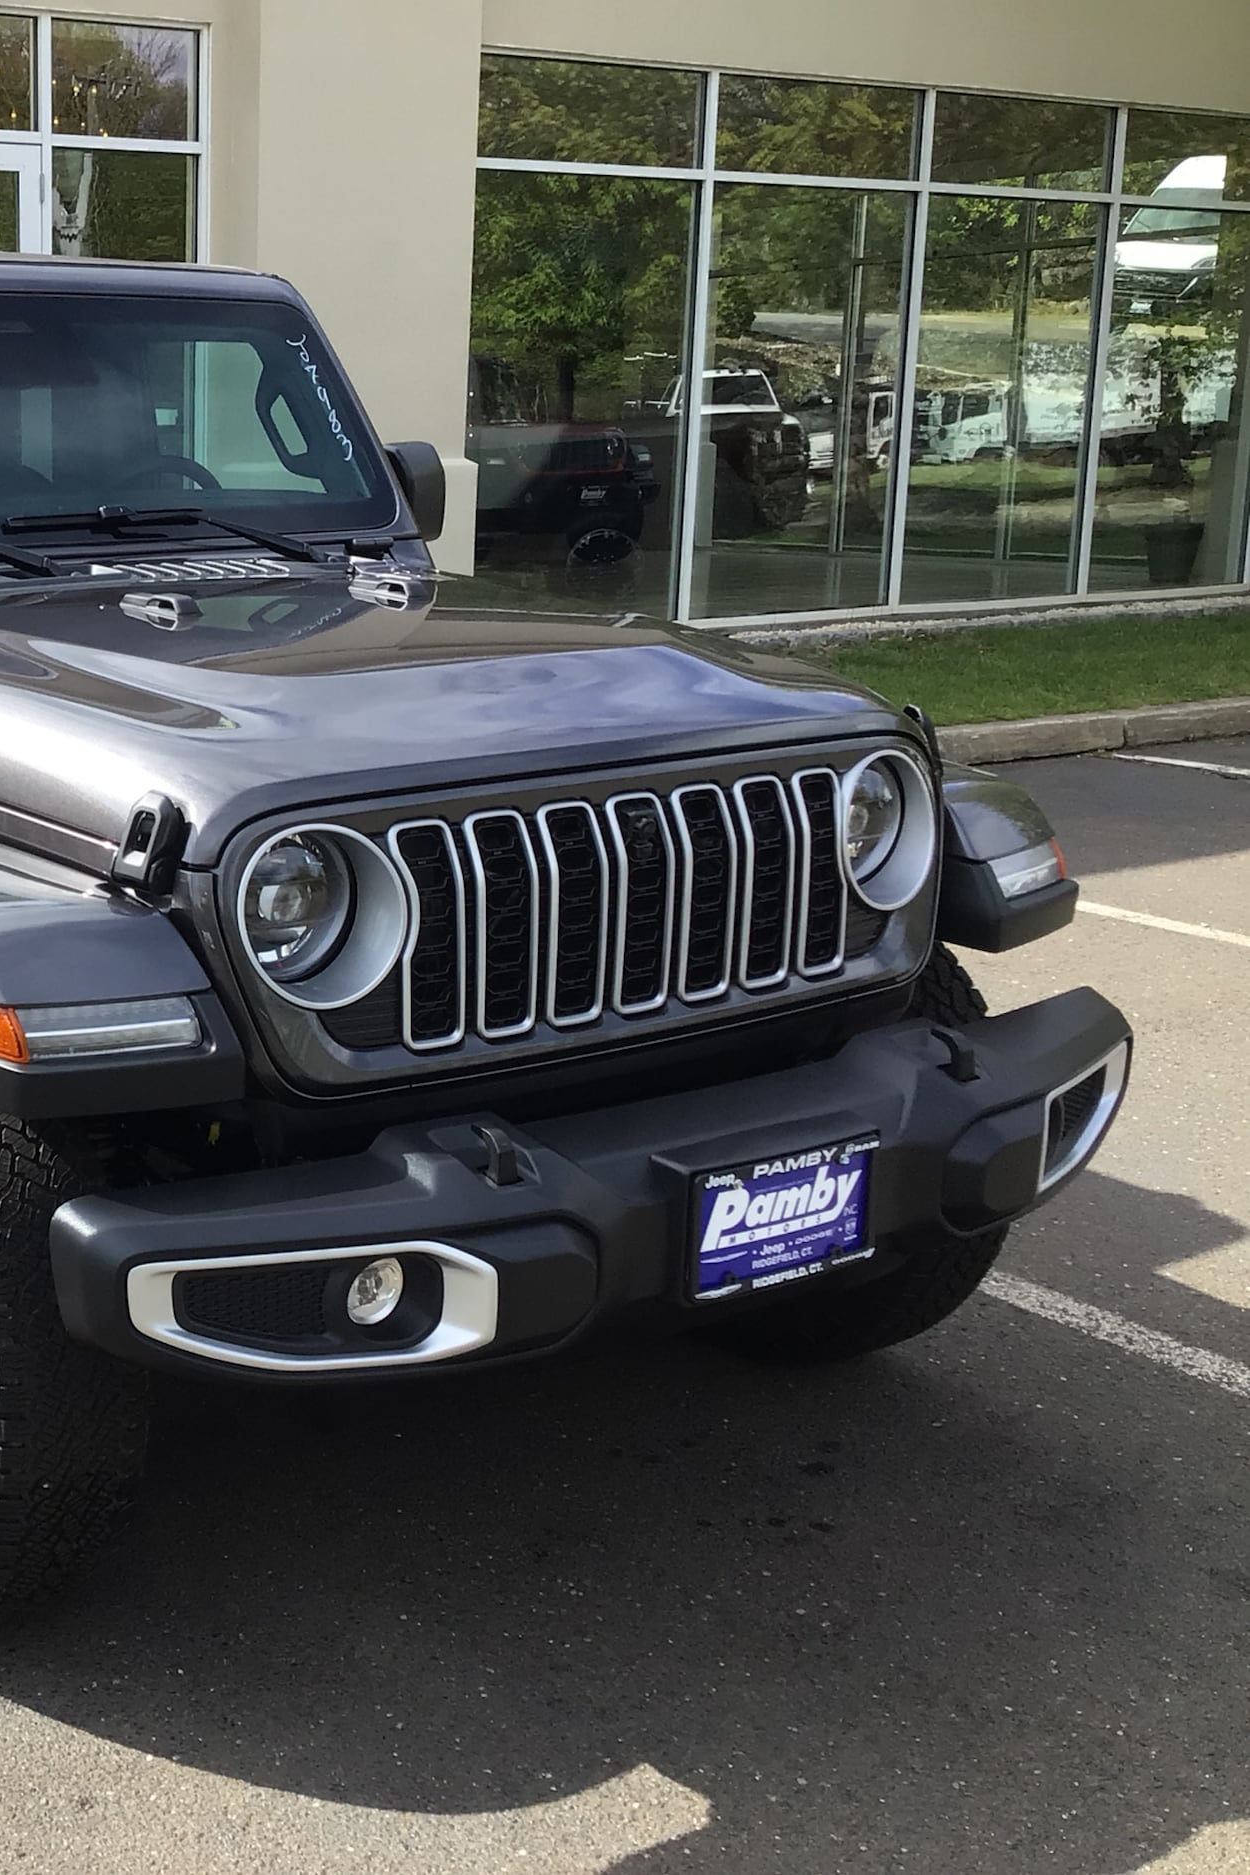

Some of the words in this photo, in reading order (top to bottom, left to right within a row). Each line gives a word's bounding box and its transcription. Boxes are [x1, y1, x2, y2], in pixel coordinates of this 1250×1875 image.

[753, 1147, 838, 1180] PAMBY
[705, 1173, 736, 1189] Jeep
[700, 1165, 863, 1253] Pamby
[759, 1240, 785, 1257] Jeep
[795, 1228, 834, 1245] DODGE
[809, 1262, 825, 1275] CT.
